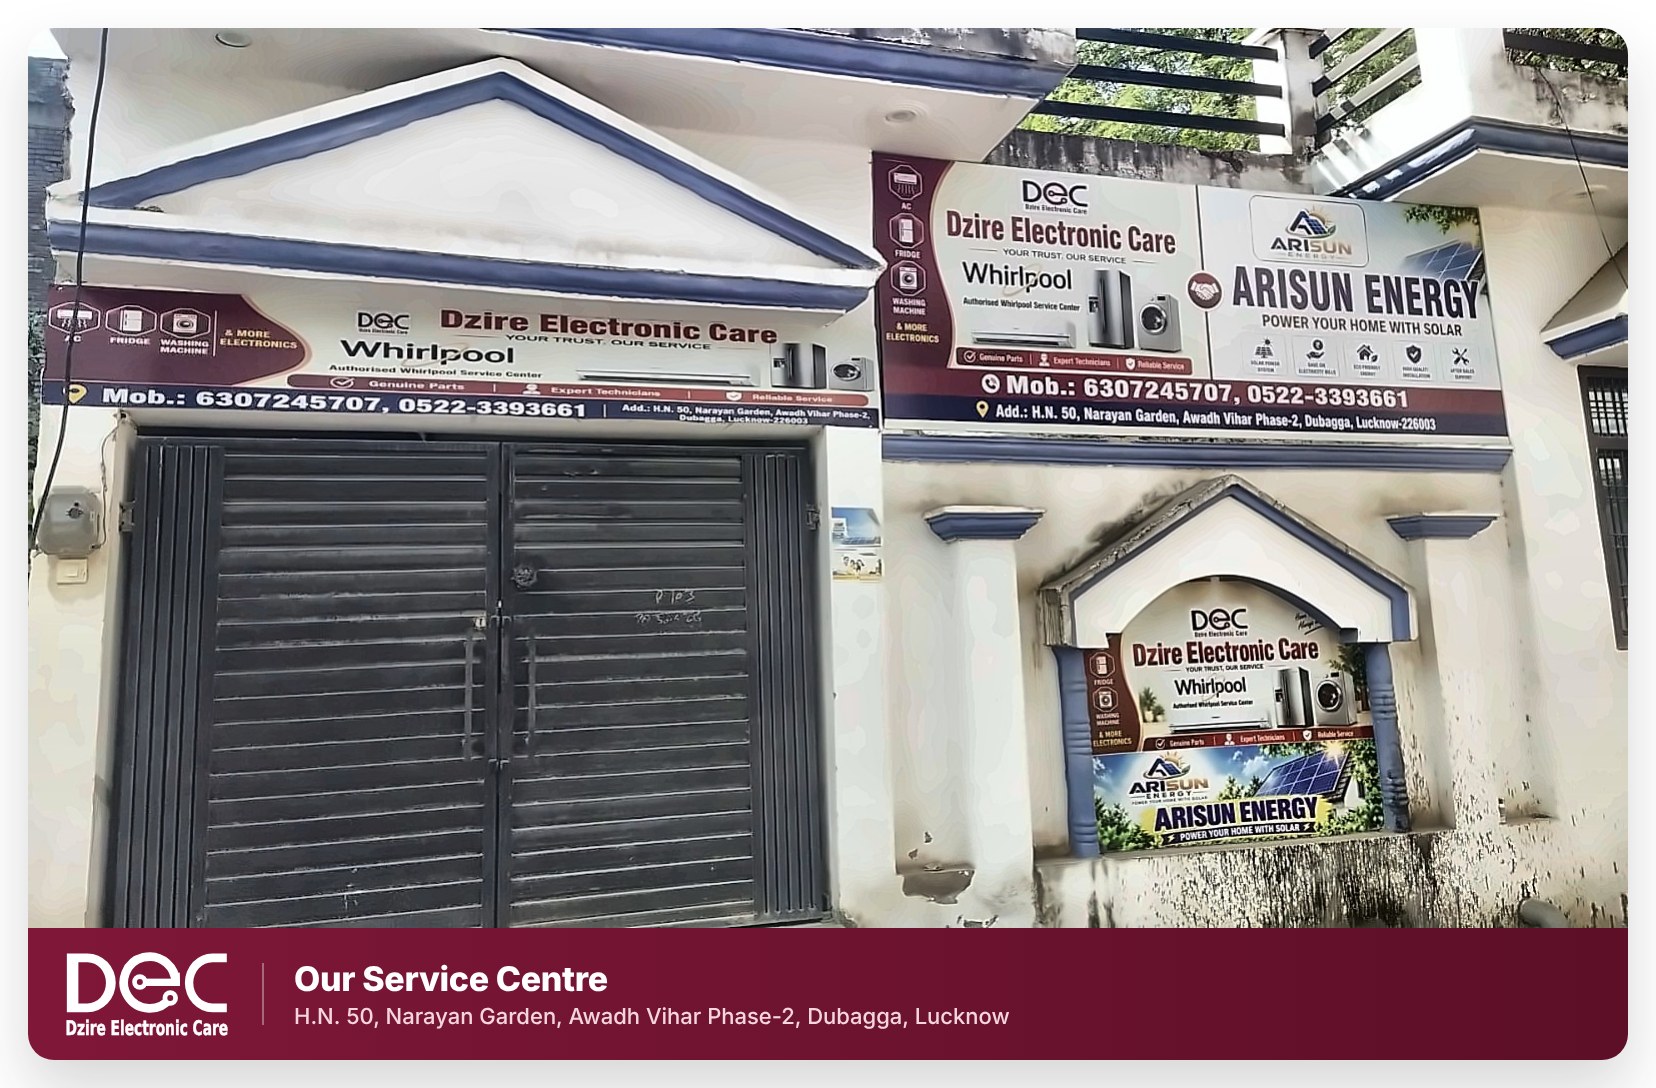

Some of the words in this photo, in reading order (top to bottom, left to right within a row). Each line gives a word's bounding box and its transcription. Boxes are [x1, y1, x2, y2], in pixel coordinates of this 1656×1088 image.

[901, 202, 912, 210] AC
[946, 210, 1004, 241] Dzire
[1011, 216, 1121, 251] Electronic
[1128, 225, 1176, 254] Care
[1270, 236, 1353, 255] ARISUN
[894, 250, 921, 258] FRIDGE
[1003, 248, 1029, 257] YOUR
[1066, 253, 1086, 261] OUR
[1089, 254, 1126, 264] SERVICE
[1287, 252, 1335, 260] ENERGY
[962, 261, 1072, 293] Whirlpool
[1232, 266, 1354, 313] ARISUN
[1364, 274, 1480, 320] ENERGY
[893, 298, 926, 307] WASHING
[963, 297, 999, 307] Authorised
[1001, 299, 1032, 310] Whirlpool
[1034, 301, 1058, 311] Service
[1059, 303, 1080, 312] Center
[893, 306, 926, 316] MACHINE
[441, 309, 529, 332] Dzire
[540, 314, 700, 340] Electronic
[709, 323, 778, 344] Care
[904, 323, 928, 331] MORE
[1262, 314, 1309, 330] POWER
[1312, 317, 1346, 331] YOUR
[1351, 319, 1387, 333] HOME
[1389, 320, 1421, 335] WITH
[1424, 322, 1462, 336] SOLAR
[237, 329, 270, 339] MORE
[886, 332, 940, 343] ELECTRONICS
[110, 336, 150, 345] FRIDGE
[161, 338, 209, 347] WASHING
[220, 338, 297, 349] ELECTRONICS
[506, 334, 549, 342] YOUR
[611, 338, 644, 347] OUR
[649, 341, 712, 350] SERVICE
[160, 346, 209, 355] MACHINE
[340, 339, 514, 365] Whirlpool
[979, 353, 1005, 362] Genuine
[1006, 354, 1023, 363] Parts
[1053, 357, 1074, 367] Expert
[1075, 358, 1111, 367] Technicians
[1137, 360, 1161, 369] Reliable
[1163, 361, 1185, 370] Service
[329, 364, 396, 373] Authorised
[400, 367, 457, 376] Whirlpool
[460, 369, 502, 377] Service
[505, 371, 542, 379] Center
[369, 380, 427, 389] Genuine
[429, 382, 465, 391] Parts
[551, 386, 593, 395] Expert
[595, 387, 661, 397] Technicians
[1006, 375, 1075, 396] Mob.:
[1084, 378, 1240, 405] 6307245707,
[1247, 385, 1409, 409] 0522-3393661
[102, 387, 186, 405] Mob.:
[196, 391, 389, 414] 6307245707,
[399, 398, 586, 417] 0522-3393661
[752, 394, 793, 402] Reliable
[796, 395, 833, 403] Service
[622, 403, 651, 412] Add.:
[653, 404, 674, 413] H.N.
[676, 405, 693, 415] 50,
[695, 405, 735, 416] Narayan
[737, 407, 774, 417] Garden,
[775, 408, 806, 417] Awadh
[807, 409, 831, 418] Vihar
[833, 410, 871, 420] Phase-2,
[679, 413, 726, 424] Dubagga,
[727, 416, 808, 425] Lucknow-226003
[996, 404, 1028, 418] Add.:
[1032, 405, 1058, 420] H.N.
[1061, 406, 1080, 421] 50,
[1084, 407, 1132, 424] Narayan
[1135, 409, 1180, 425] Garden,
[1183, 411, 1221, 425] Awadh
[1223, 412, 1252, 425] Vihar
[1255, 414, 1302, 429] Phase-2,
[1305, 414, 1354, 431] Dubagga,
[1356, 416, 1437, 431] Lucknow-226003
[1132, 642, 1183, 667] Dzire
[1186, 639, 1275, 664] Electronic
[1278, 637, 1319, 661] Care
[1240, 663, 1264, 671] SERVICE
[1174, 676, 1247, 698] Whirlpool
[1093, 738, 1132, 747] ELECTRONICS
[1191, 739, 1205, 747] Parts
[1240, 735, 1256, 744] Expert
[1257, 734, 1285, 742] Technicians
[1129, 778, 1209, 795] ARISUN
[1146, 791, 1192, 799] ENERGY
[1154, 803, 1236, 832] ARISUN
[1240, 797, 1318, 822] ENERGY
[1179, 831, 1207, 841] POWER
[1209, 829, 1229, 838] YOUR
[1231, 827, 1252, 836] HOME
[1254, 825, 1274, 833] WITH
[1275, 824, 1300, 832] SOLAR
